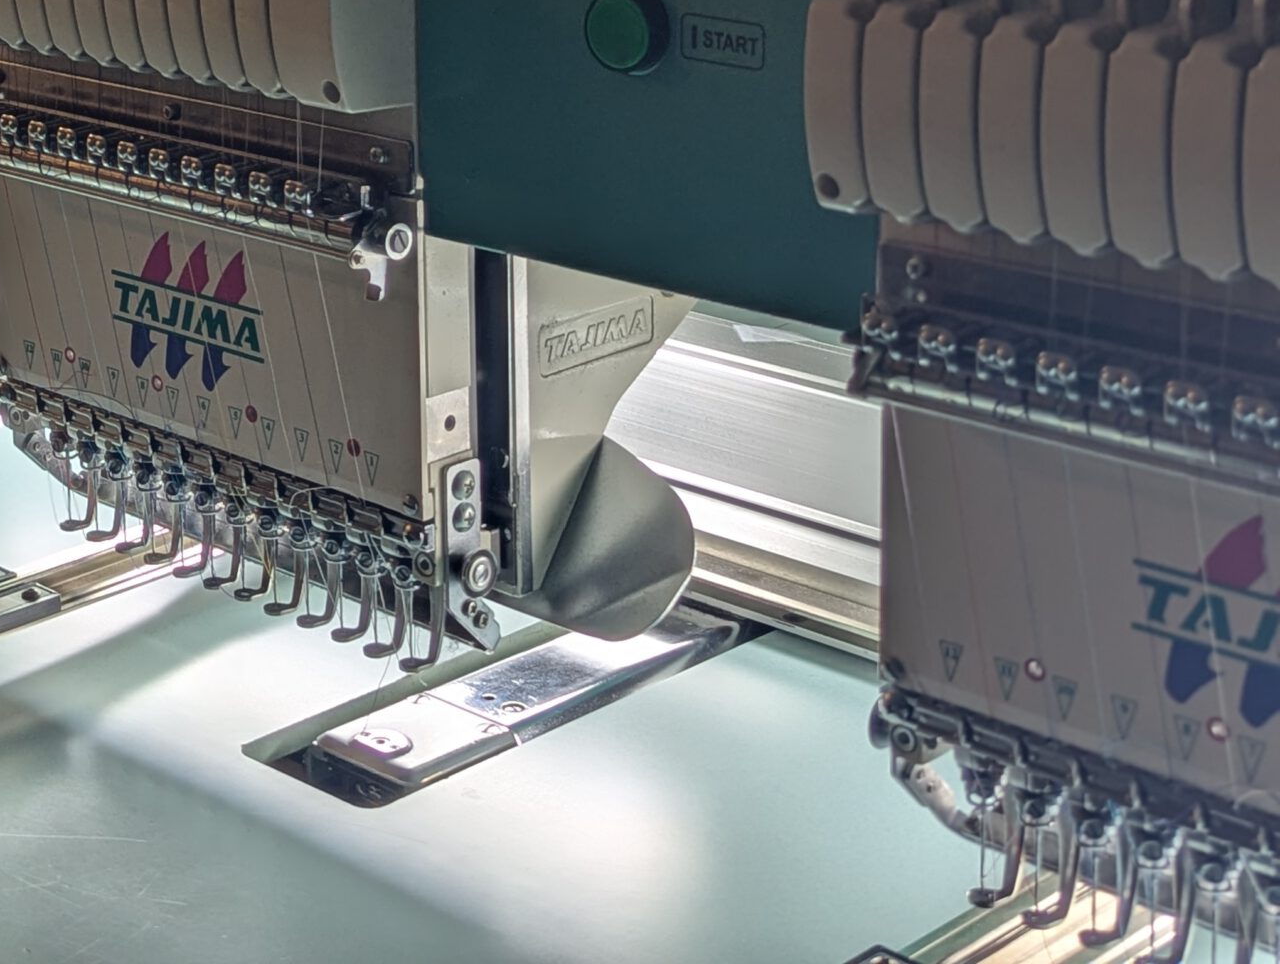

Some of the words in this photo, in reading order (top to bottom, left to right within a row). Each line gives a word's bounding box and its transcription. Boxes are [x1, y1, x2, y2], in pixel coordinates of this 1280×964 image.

[702, 29, 760, 56] START
[114, 279, 261, 353] TAJIMA
[544, 307, 648, 364] TAJIMA
